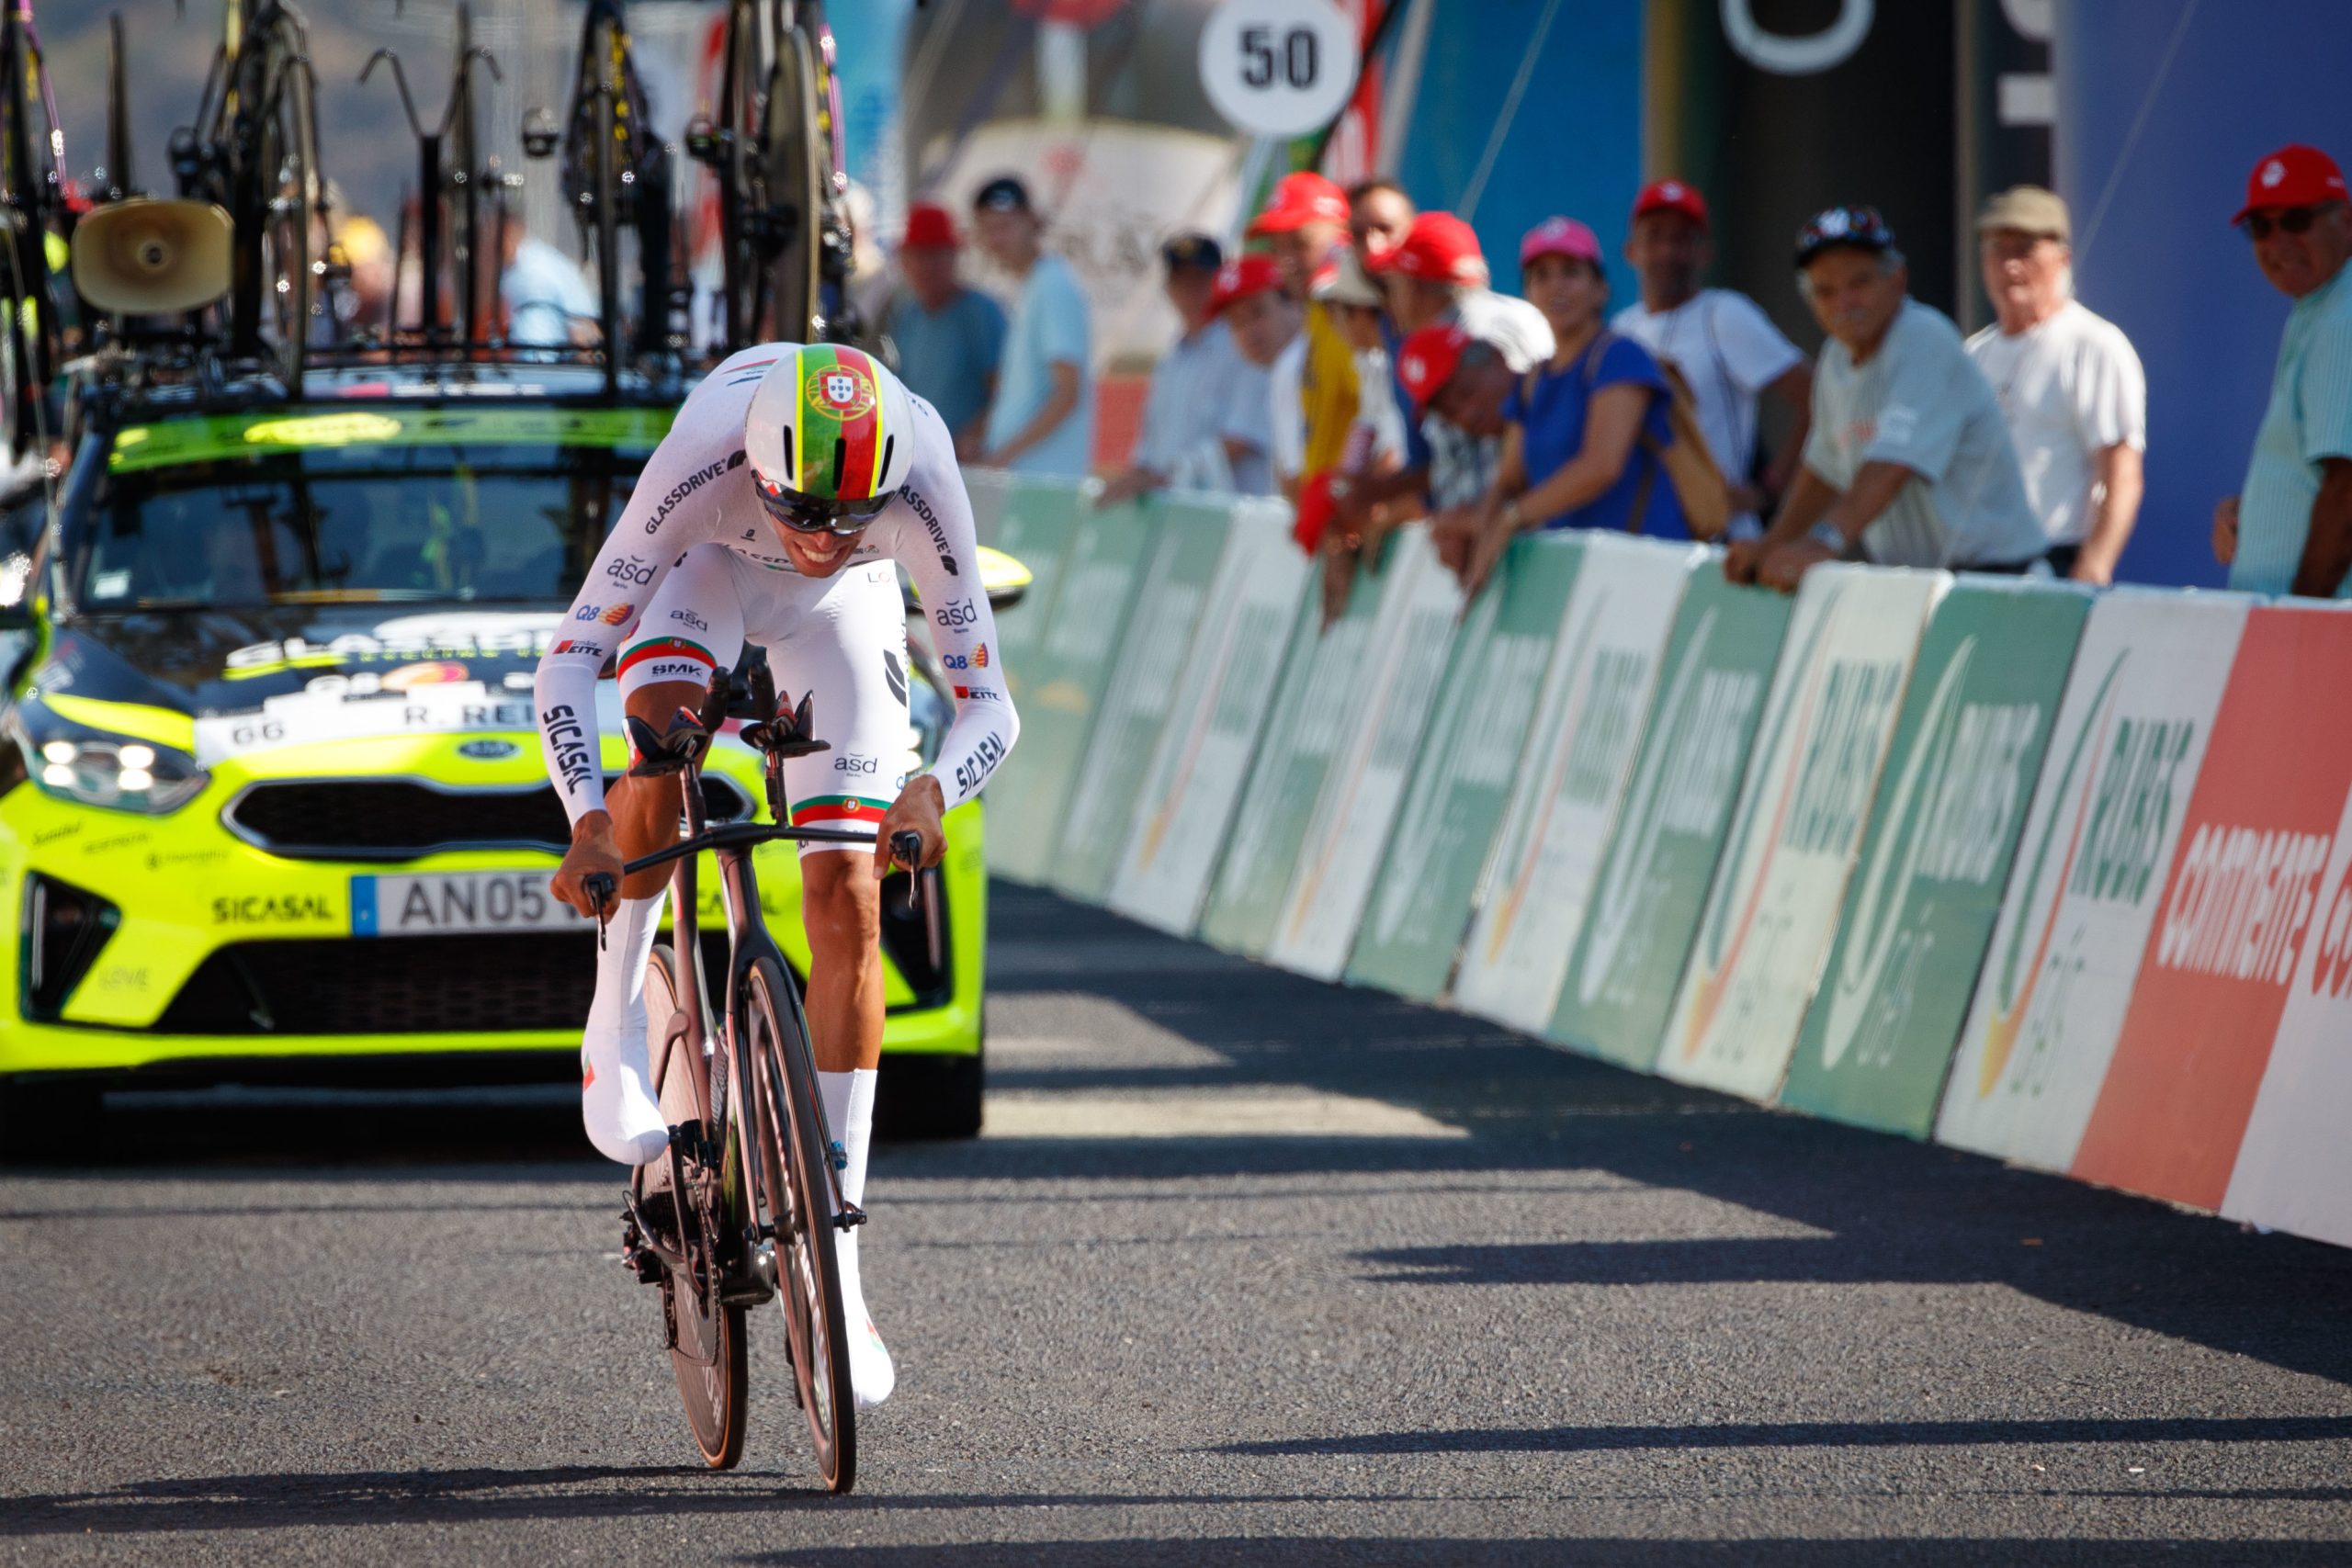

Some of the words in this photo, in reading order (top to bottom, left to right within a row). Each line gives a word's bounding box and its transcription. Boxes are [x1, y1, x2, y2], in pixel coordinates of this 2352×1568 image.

[1240, 30, 1317, 87] 50
[899, 484, 950, 554] ASSDRIVE
[575, 604, 601, 622] Q8
[944, 654, 968, 670] Q8
[462, 704, 533, 724] REI
[232, 721, 284, 746] 66
[542, 705, 594, 795] SICASAL
[956, 730, 1007, 798] SICASAL
[211, 897, 333, 924] SICASAL
